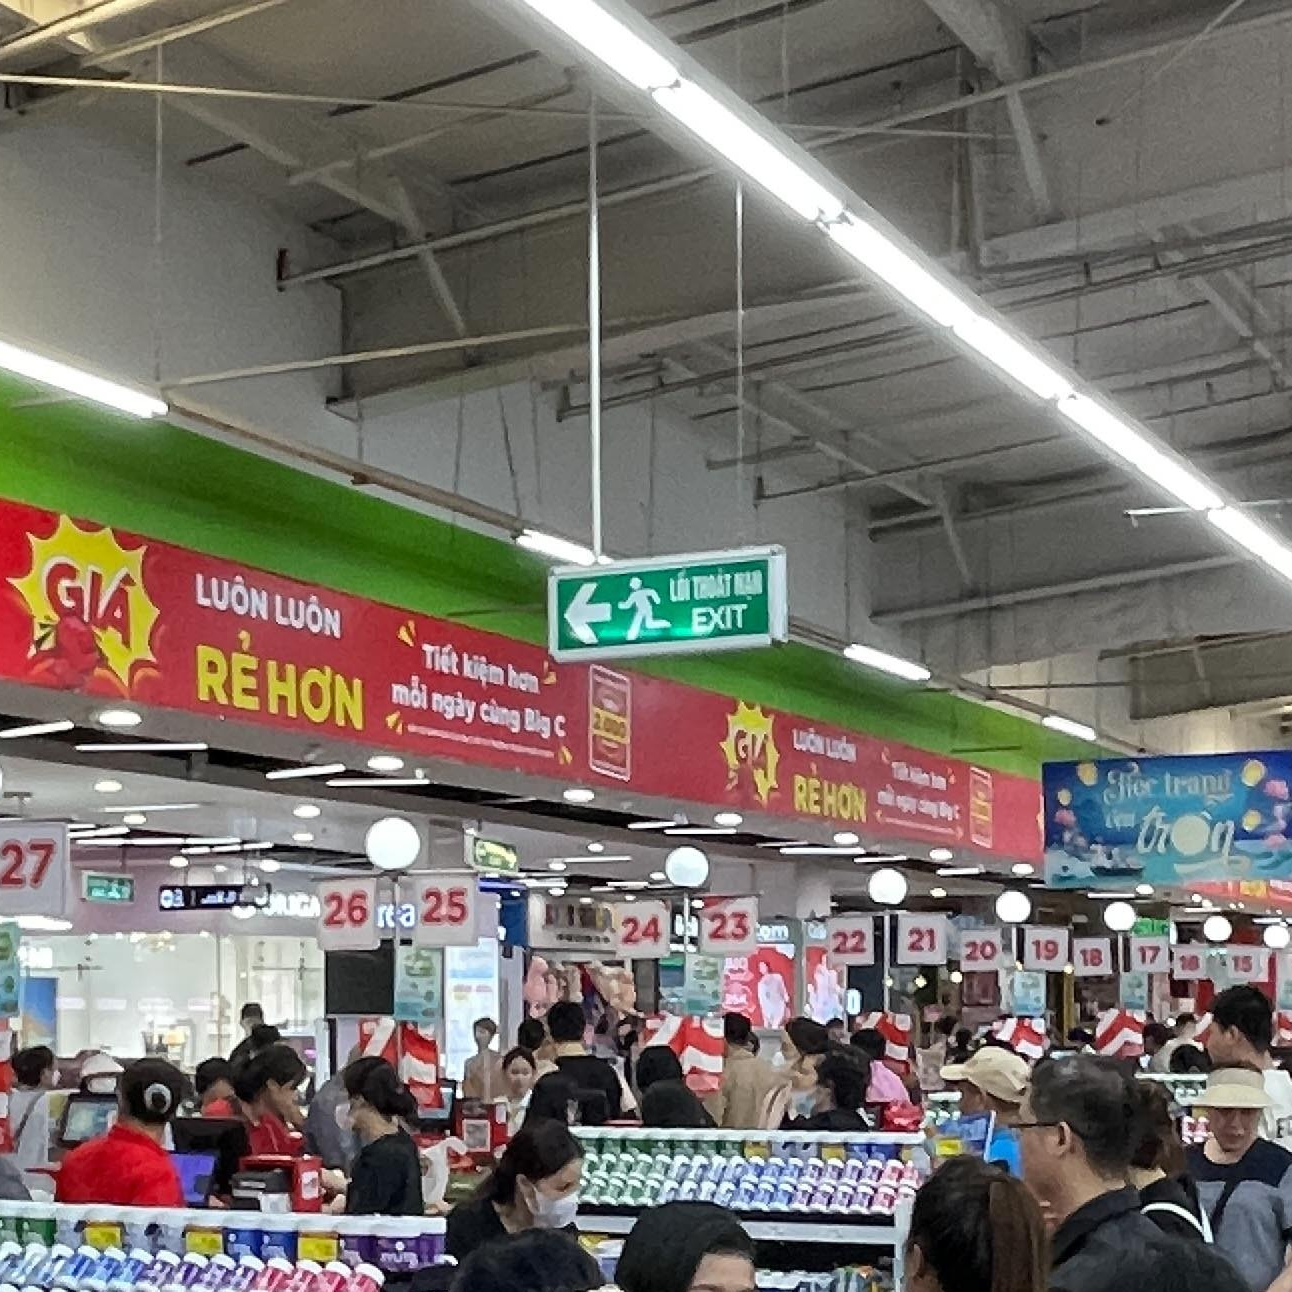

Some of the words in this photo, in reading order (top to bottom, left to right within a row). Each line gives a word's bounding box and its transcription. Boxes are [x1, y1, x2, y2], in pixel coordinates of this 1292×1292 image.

[195, 572, 271, 620] LUÔN
[274, 593, 343, 639] LUÔN
[691, 604, 749, 635] EXIT
[196, 630, 260, 711] RẺ
[268, 664, 366, 731] HƠN
[554, 715, 568, 737] C
[323, 890, 369, 929] 26
[421, 887, 469, 926] 25
[621, 915, 661, 946] 24
[709, 912, 751, 941] 23
[908, 927, 936, 952] 21
[832, 930, 867, 953] 22
[964, 940, 997, 961] 20
[1032, 940, 1058, 960] 19
[1139, 945, 1161, 965] 17
[1080, 948, 1103, 967] 18
